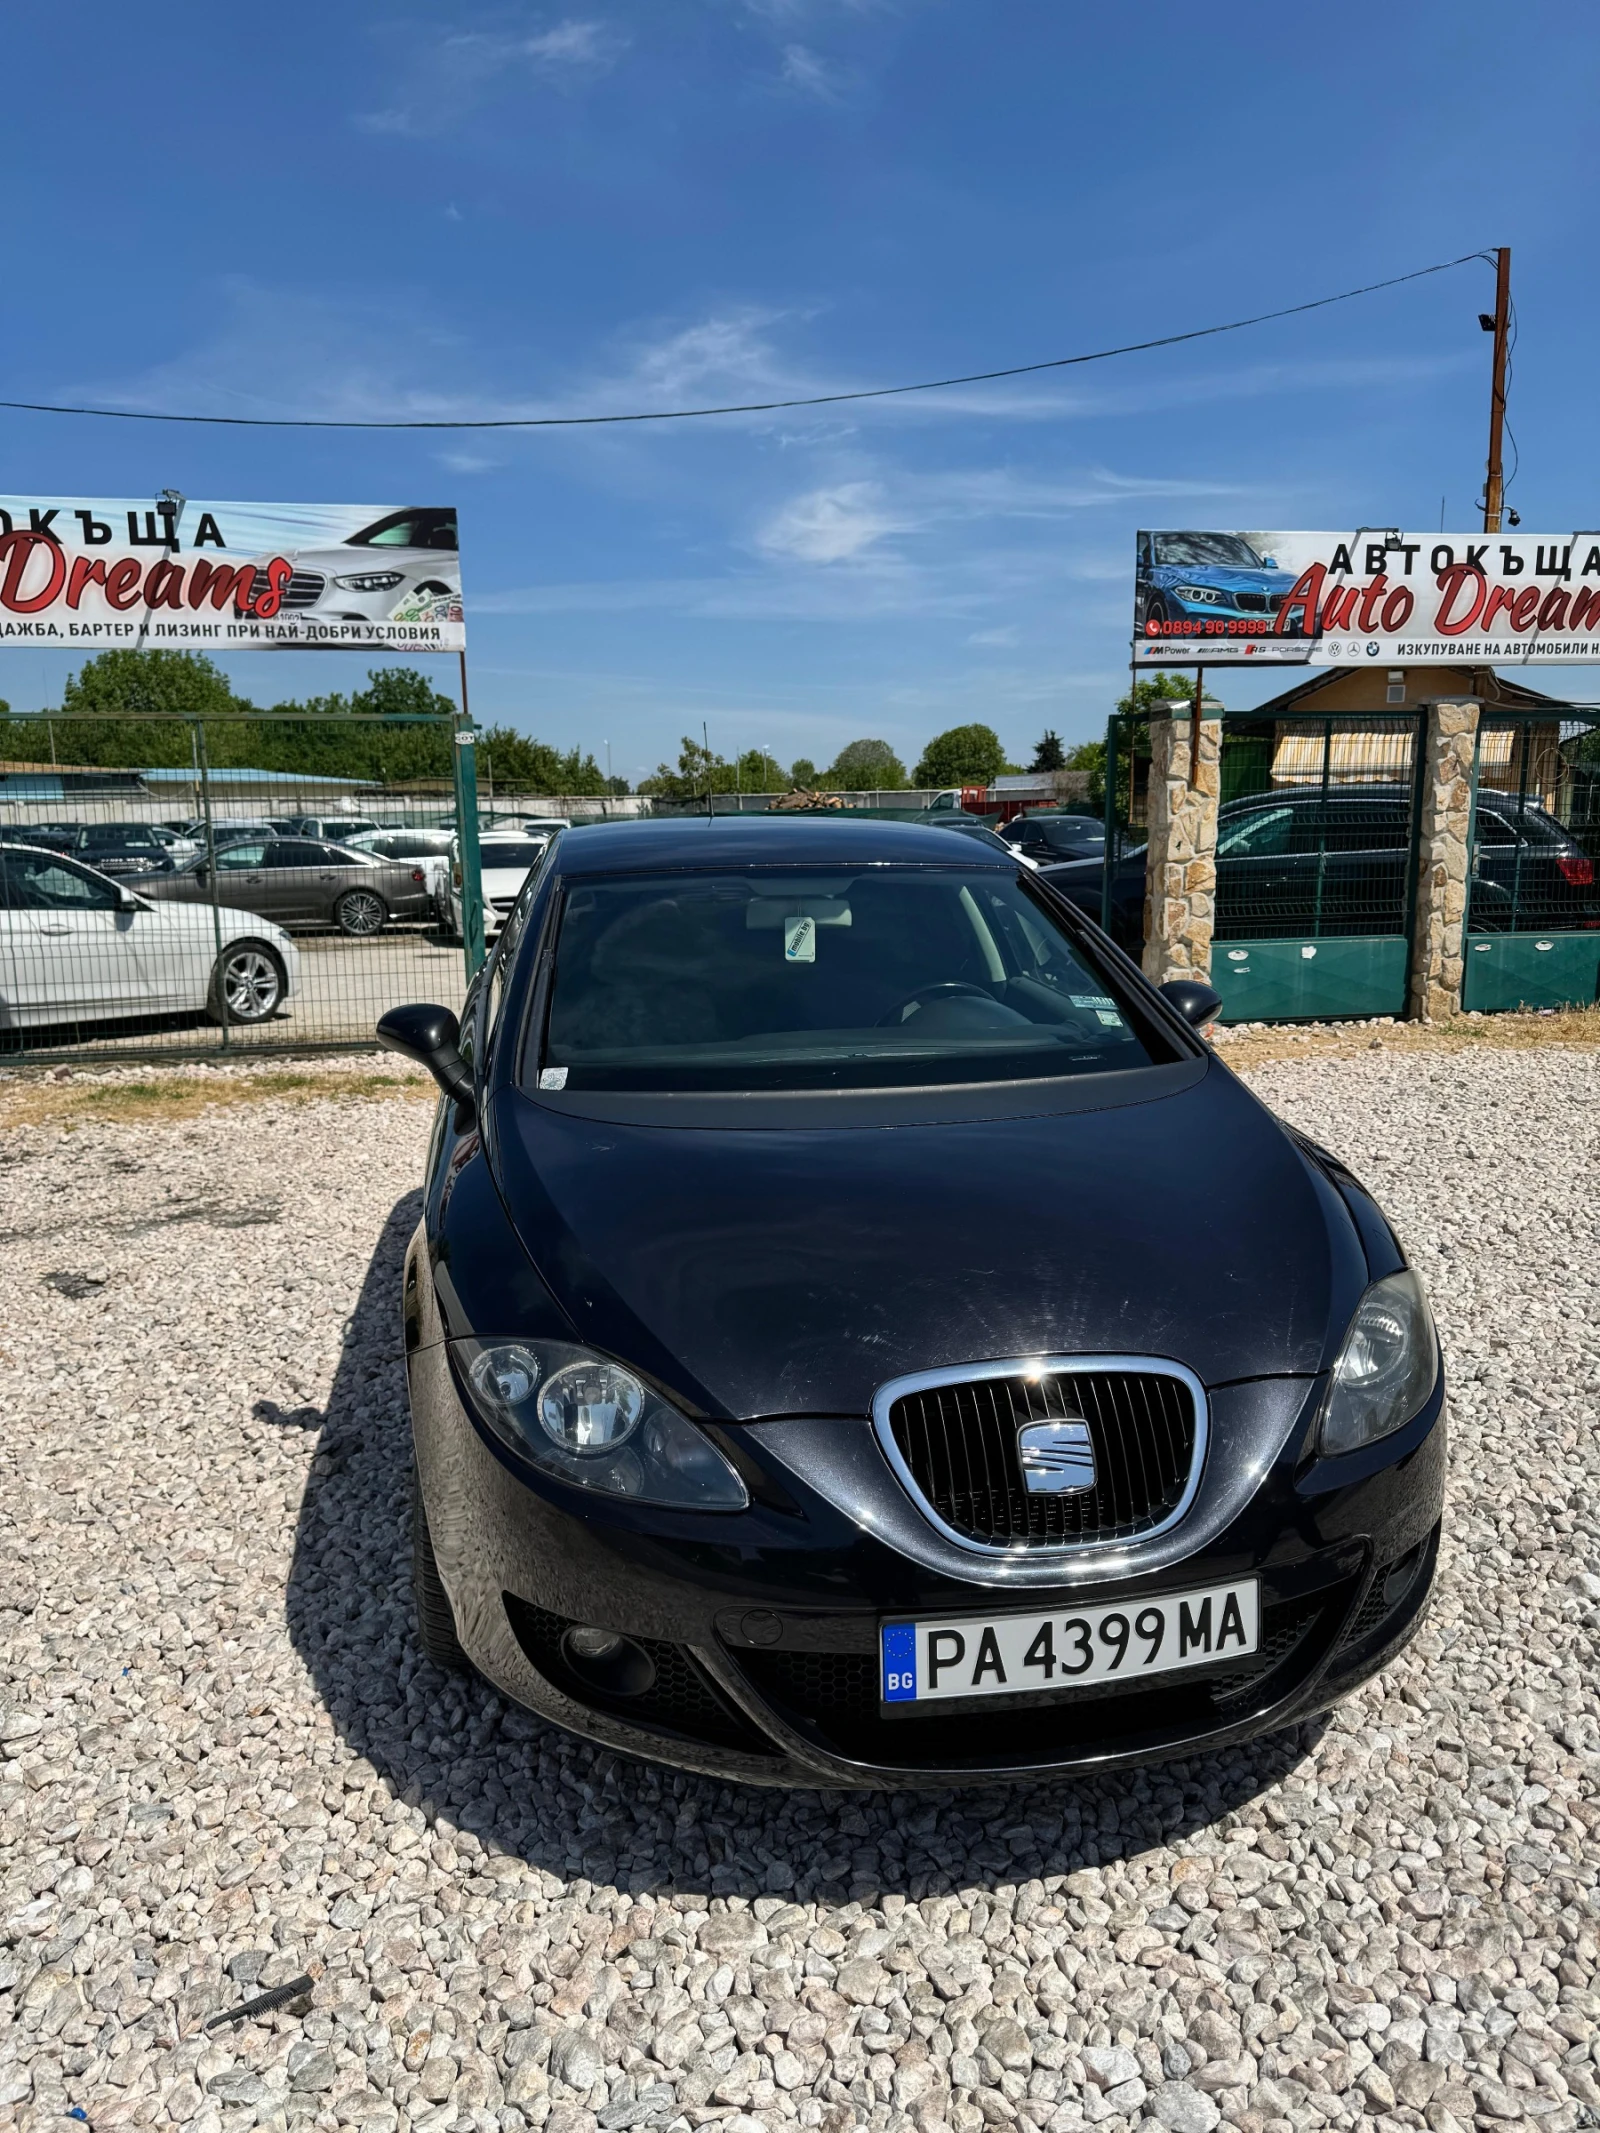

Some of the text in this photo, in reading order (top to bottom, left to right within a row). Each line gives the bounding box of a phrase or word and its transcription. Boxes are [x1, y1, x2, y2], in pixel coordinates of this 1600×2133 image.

[0, 529, 293, 618] Dreams
[1328, 543, 1600, 582] АВТОКЪЩА
[1274, 562, 1414, 636] Auto
[0, 622, 440, 640] АЖБА, БАРТЕР И ЛИЗИНГ ПРИ НАЙ-ДОБРИ УСЛОВИЯ
[1162, 620, 1202, 634] 0894
[1205, 620, 1225, 634] 90
[1227, 620, 1267, 634] 9999
[1397, 643, 1600, 655] ИЗКУПУВАНЕ НА АВТОМОБИЛИ Н
[927, 1592, 1248, 1690] PA 4399 MA
[888, 1672, 913, 1692] BG
